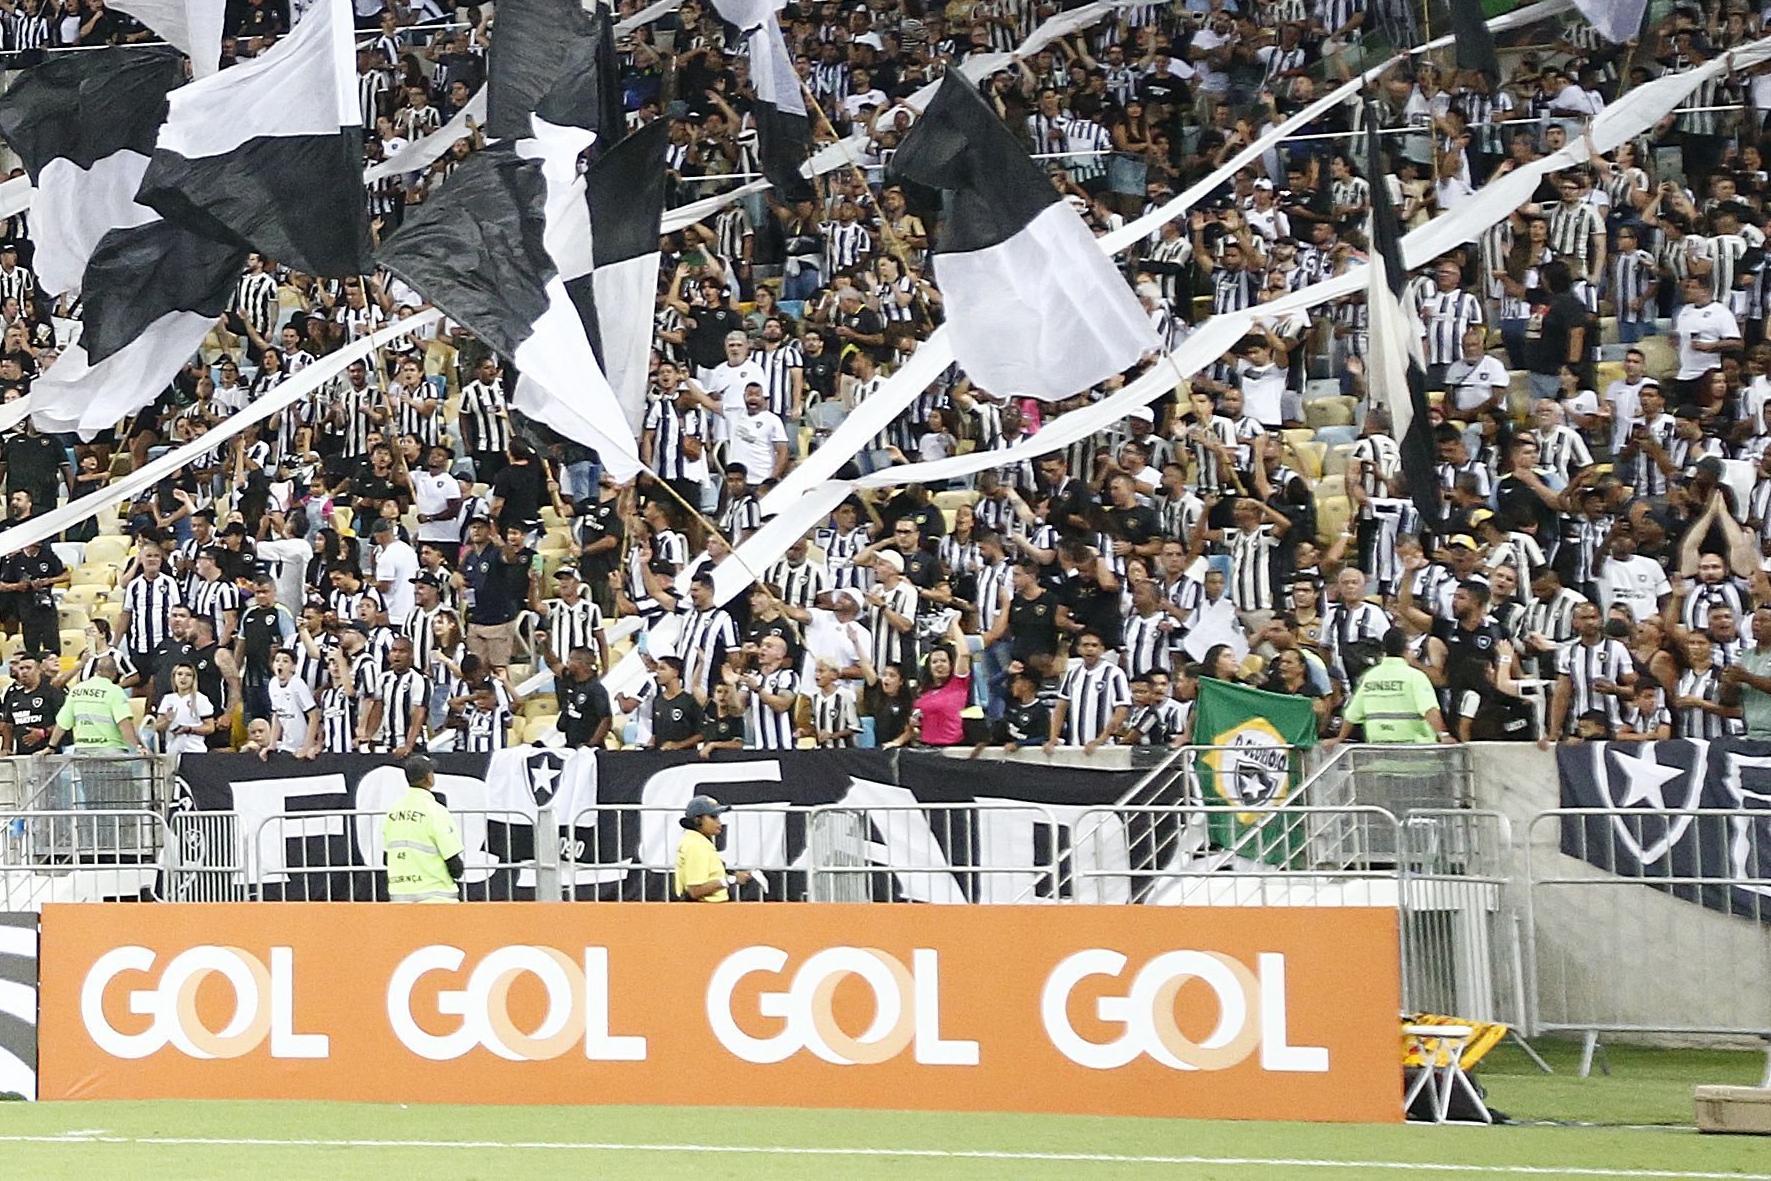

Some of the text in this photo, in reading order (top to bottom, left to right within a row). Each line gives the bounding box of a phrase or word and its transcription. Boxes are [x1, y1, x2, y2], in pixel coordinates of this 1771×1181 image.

[1363, 681, 1404, 693] SUNSET
[72, 689, 107, 699] SUNSET
[81, 943, 1329, 1074] GOL GOL GOL GOL
